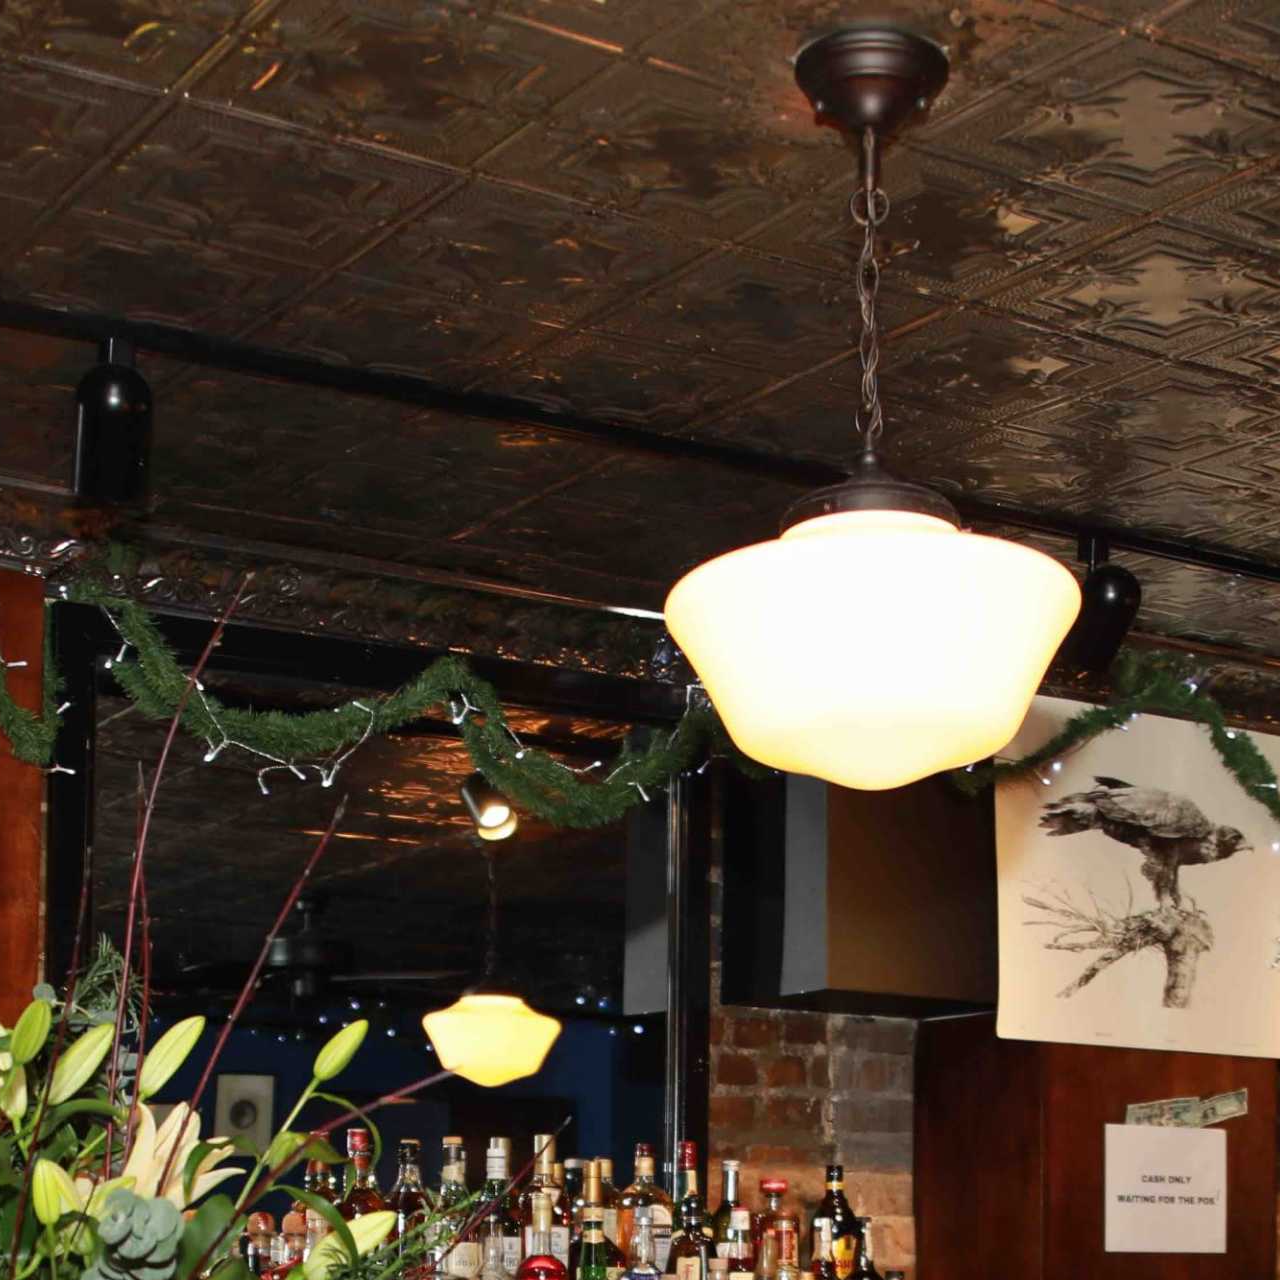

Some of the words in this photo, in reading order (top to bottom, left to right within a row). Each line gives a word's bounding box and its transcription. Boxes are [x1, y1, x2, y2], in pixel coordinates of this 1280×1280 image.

[1141, 1175, 1166, 1183] CASH
[1168, 1175, 1192, 1184] ONLY
[1117, 1195, 1156, 1204] WAITING
[1158, 1195, 1175, 1204] FOR
[1178, 1196, 1195, 1205] THE
